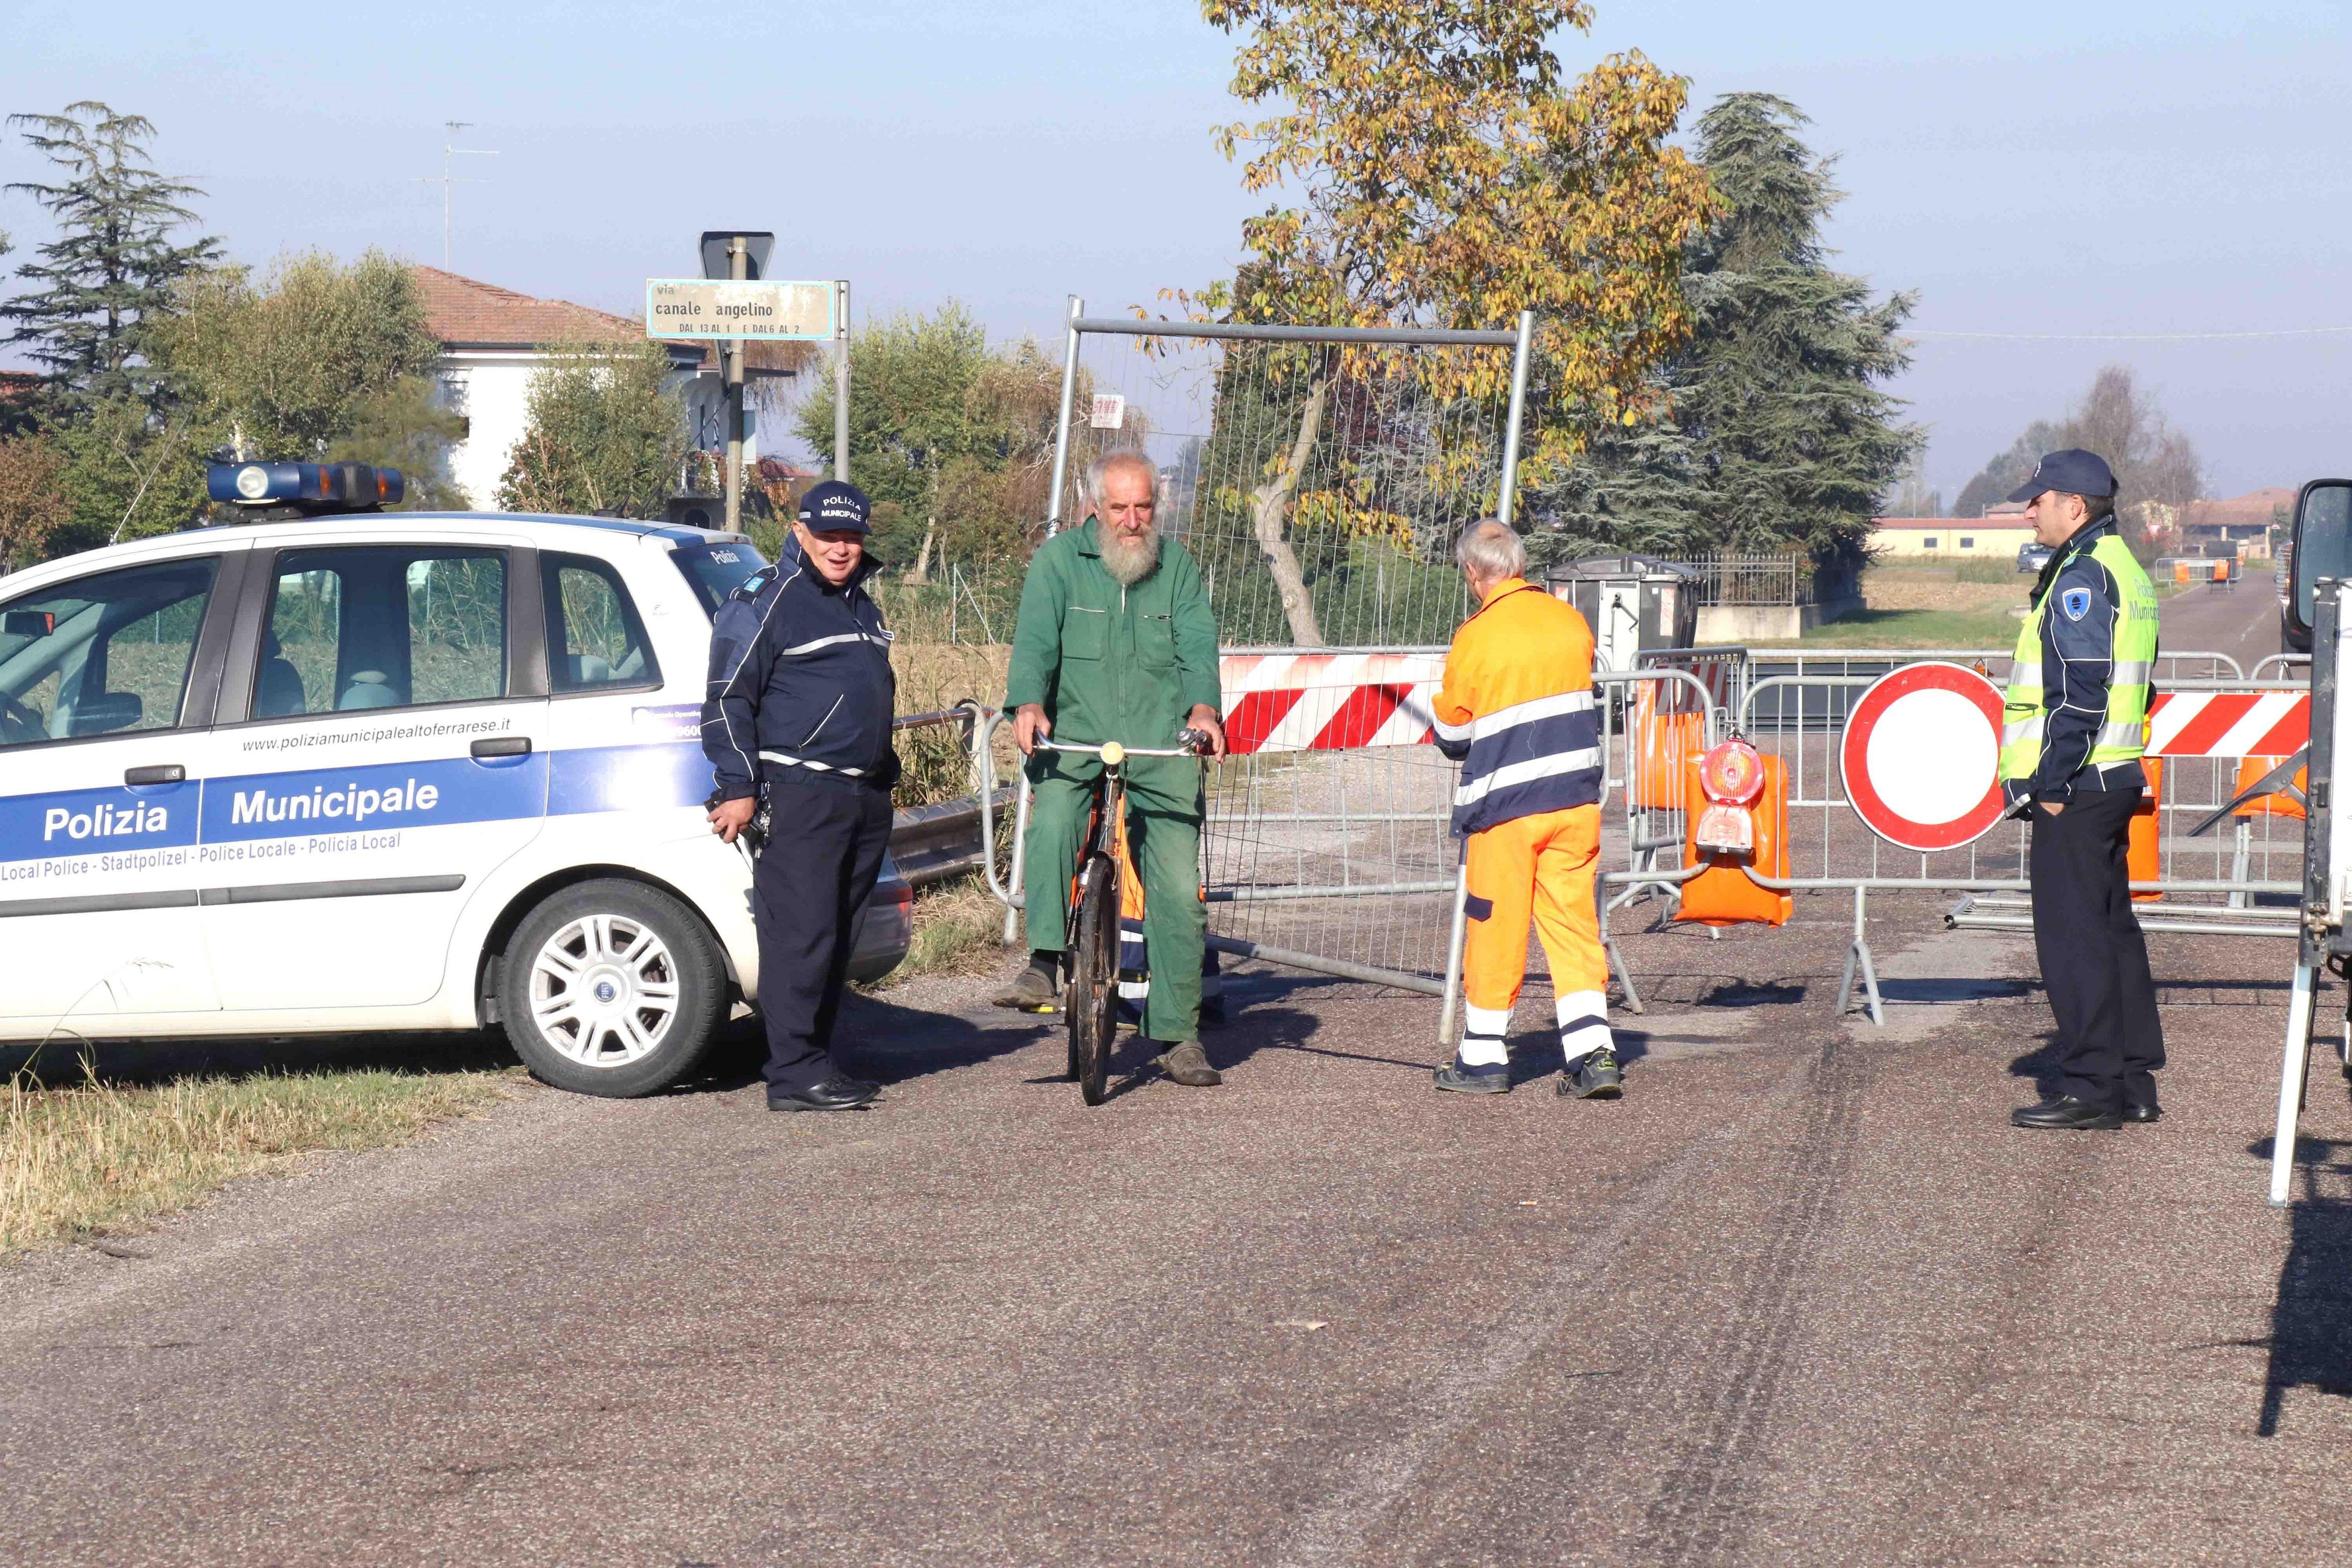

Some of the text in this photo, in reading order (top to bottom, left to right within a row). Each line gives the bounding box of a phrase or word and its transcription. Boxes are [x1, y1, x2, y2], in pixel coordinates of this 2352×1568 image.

[657, 285, 674, 294] via
[656, 301, 773, 318] canale angelino
[679, 323, 694, 333] DAL
[700, 323, 709, 333] 13
[711, 324, 720, 333] AL
[743, 324, 747, 333] E
[779, 325, 788, 334] AL
[794, 325, 800, 334] 2
[823, 495, 861, 511] POLIZIA
[821, 510, 861, 522] MUNICIPALE
[710, 549, 740, 564] Polizia
[243, 718, 511, 752] www.poliziamunicipalealtoferrarese.it
[44, 778, 439, 841] Polizia Municipale
[1, 862, 39, 881] Local
[45, 860, 88, 877] Police
[200, 846, 244, 862] Police
[249, 840, 296, 858] Locale
[309, 836, 357, 854] Policia
[362, 831, 400, 849] Local
